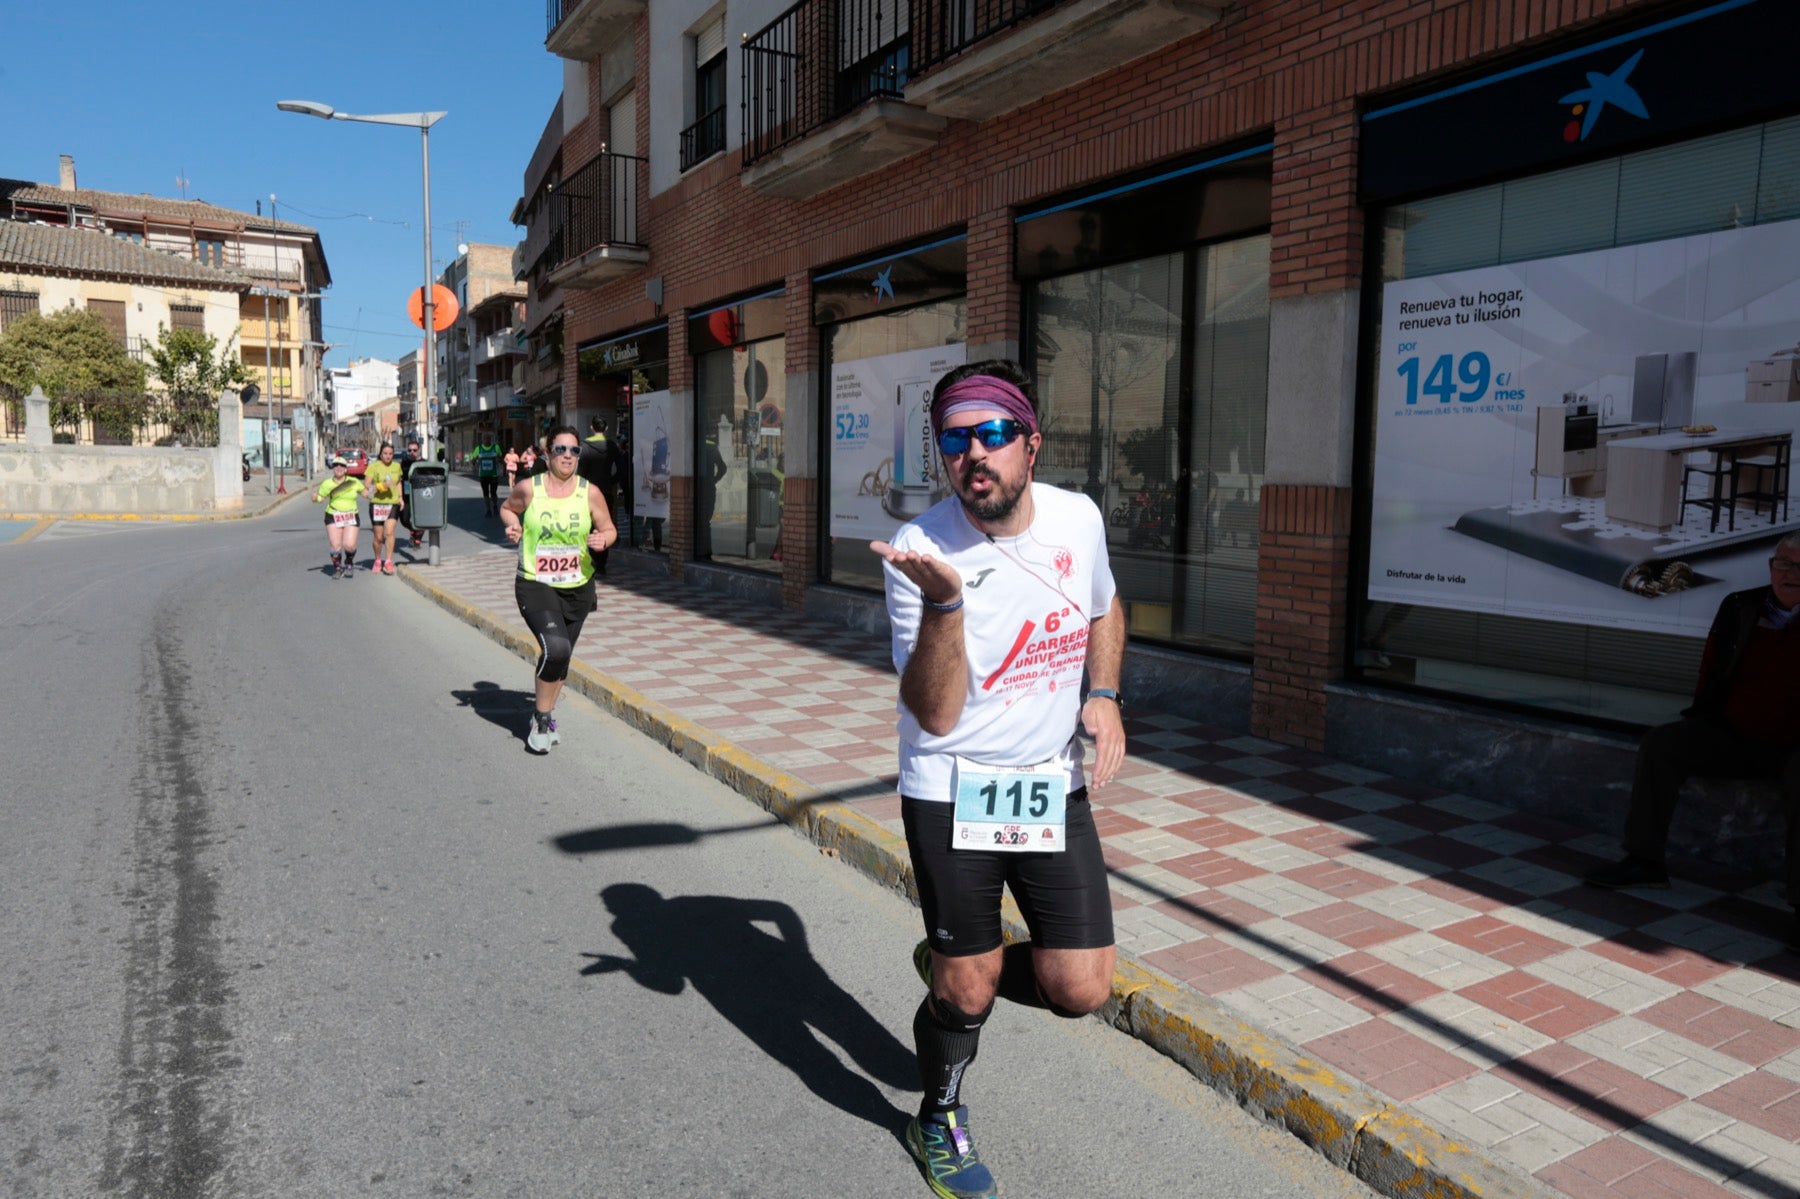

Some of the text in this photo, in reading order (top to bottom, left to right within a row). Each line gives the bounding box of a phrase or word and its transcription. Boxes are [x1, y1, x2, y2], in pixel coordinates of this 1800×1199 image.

[1400, 289, 1524, 315] Renueva tu hogar,
[1399, 305, 1521, 331] renueva tu ilusión
[1398, 341, 1417, 354] por
[1397, 350, 1491, 405] 149
[922, 390, 931, 413] 5G
[1494, 389, 1526, 400] mes
[538, 556, 579, 572] 2024
[1387, 569, 1466, 584] Disfrutar de la vida
[1003, 671, 1038, 686] CIUDAD
[980, 780, 1049, 817] 115
